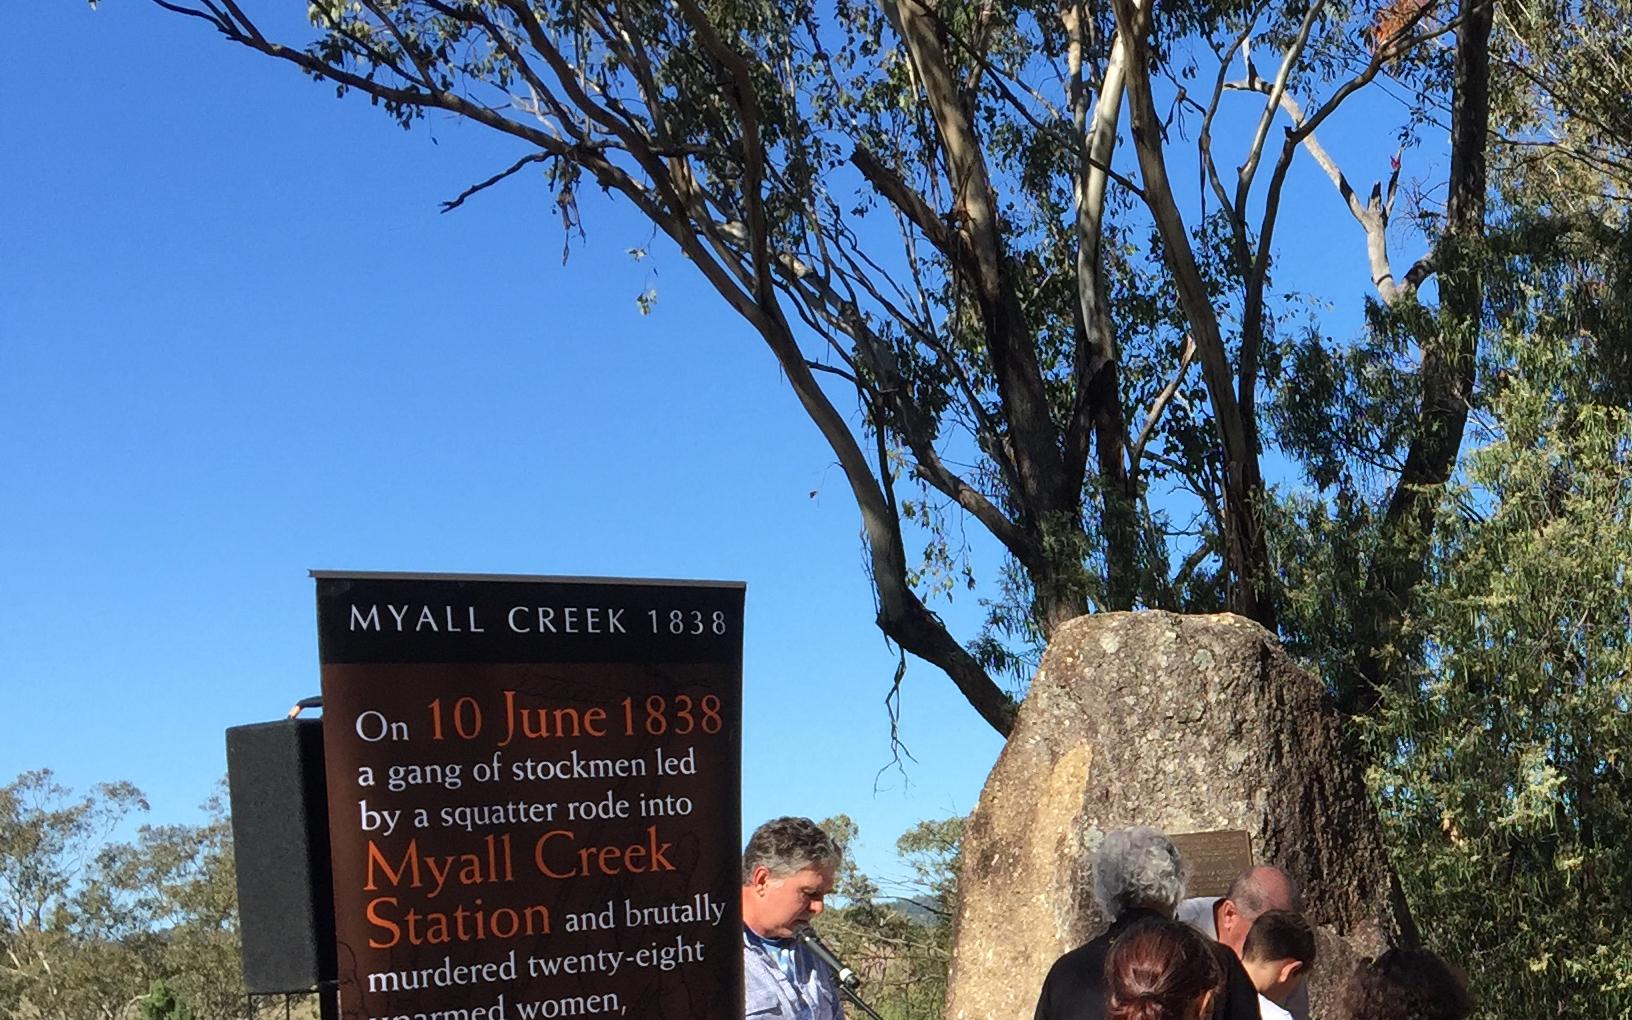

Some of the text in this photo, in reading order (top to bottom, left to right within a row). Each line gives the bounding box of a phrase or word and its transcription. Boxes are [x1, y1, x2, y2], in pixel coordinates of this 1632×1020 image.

[350, 604, 727, 635] MYALL CREEK 1838
[356, 712, 408, 742] On
[428, 697, 482, 740] 10
[498, 691, 607, 745] June
[358, 748, 696, 791] a gang of stockmen led
[359, 792, 692, 835] by a squatter rode into
[363, 826, 676, 898] Myall Creek
[367, 894, 726, 949] Station and brutally
[368, 939, 705, 992] murdered twenty-eight
[516, 994, 627, 1020] women,
